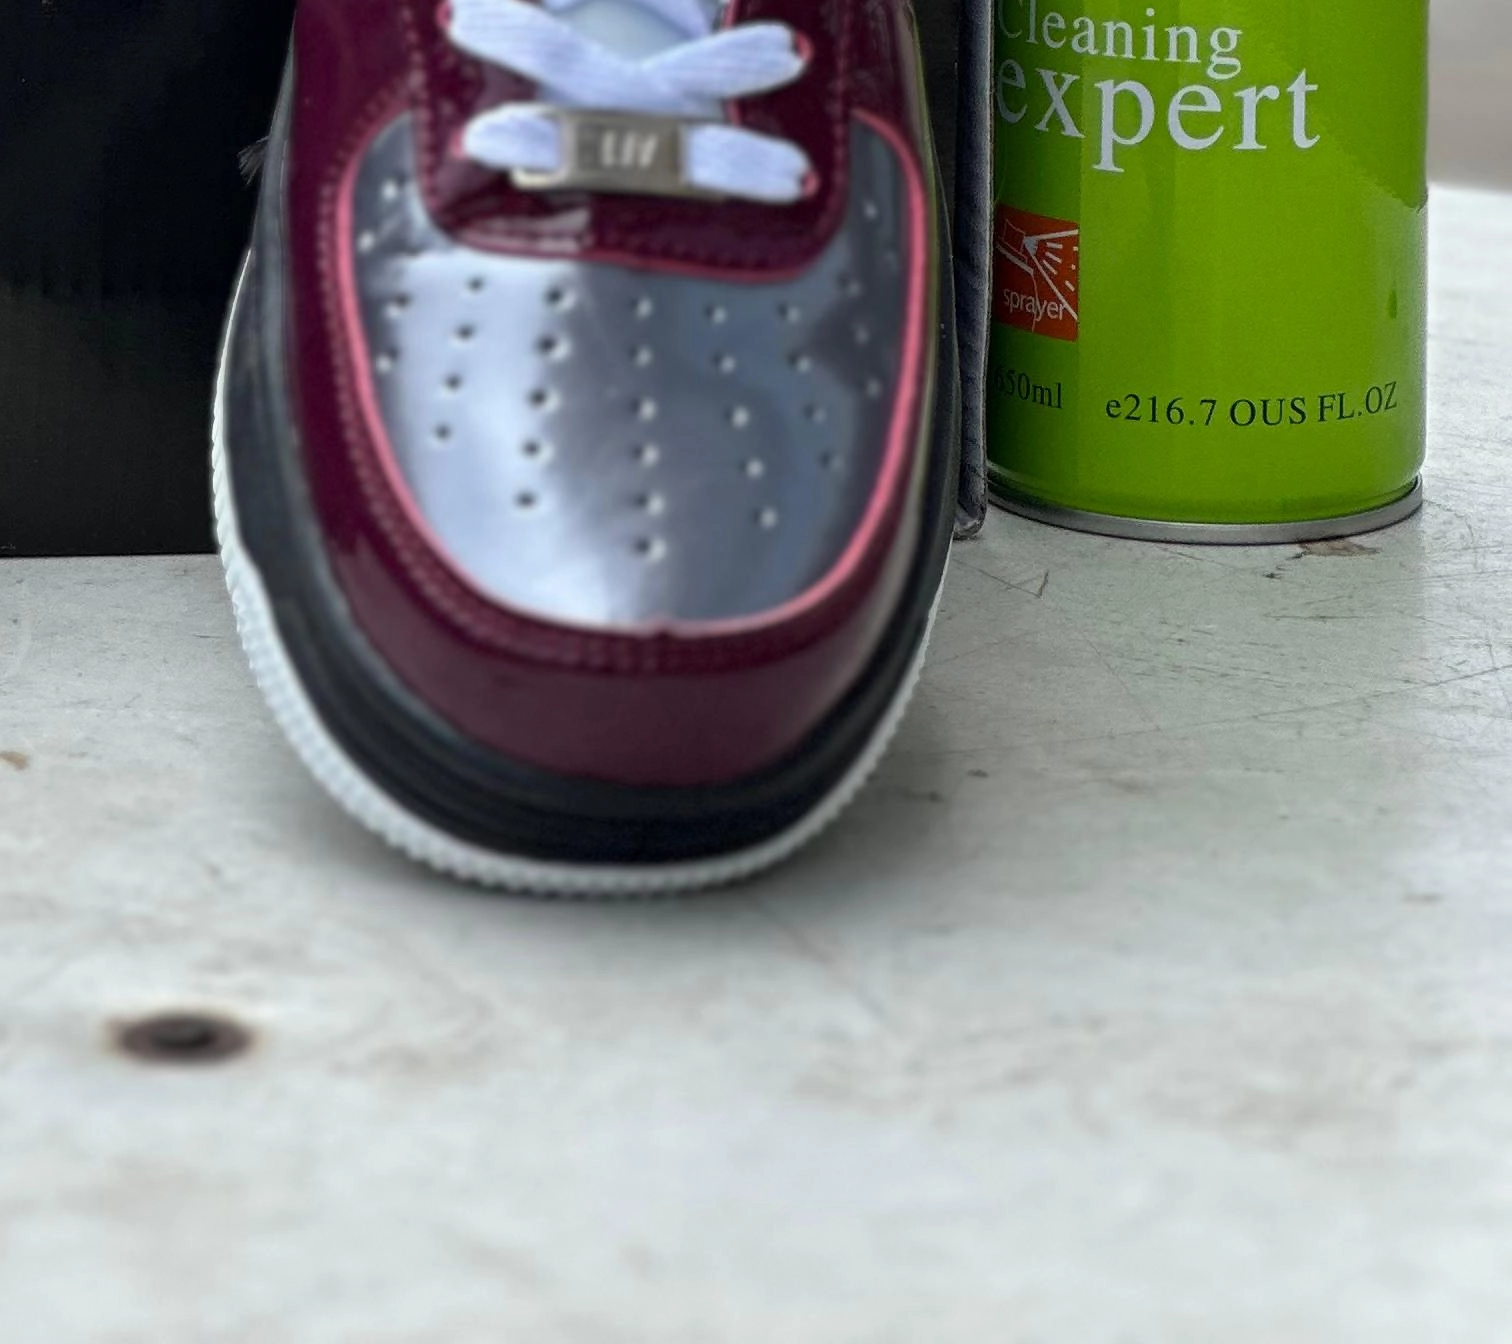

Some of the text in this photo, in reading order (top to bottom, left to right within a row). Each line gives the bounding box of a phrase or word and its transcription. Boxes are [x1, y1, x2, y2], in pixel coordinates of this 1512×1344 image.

[996, 58, 1321, 173] expert
[1003, 288, 1066, 322] sprayer
[1230, 398, 1306, 426] OUS
[1317, 380, 1398, 422] FL.OZ
